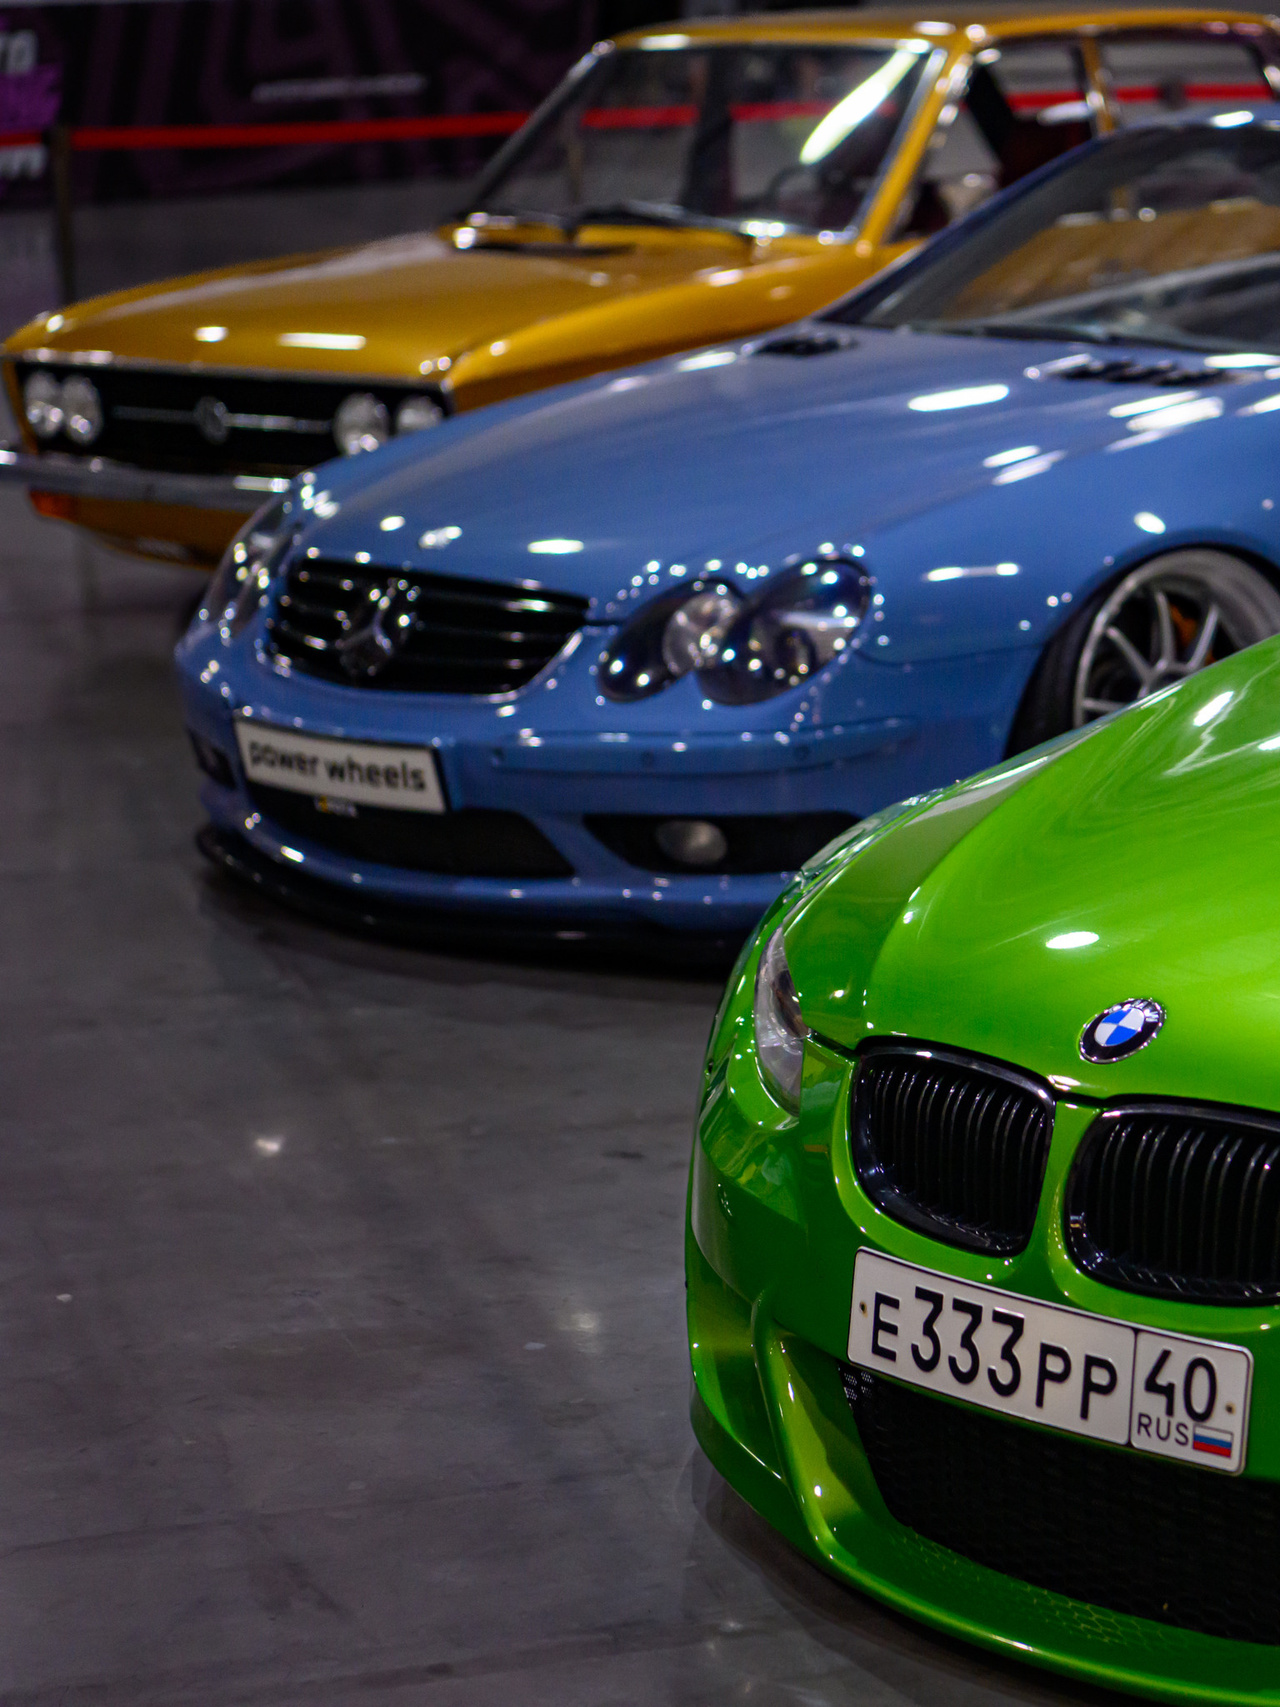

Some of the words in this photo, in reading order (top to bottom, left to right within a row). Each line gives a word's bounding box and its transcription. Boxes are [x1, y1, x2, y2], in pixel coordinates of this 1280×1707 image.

[249, 741, 319, 777] power
[325, 755, 426, 792] wheels
[1144, 1349, 1218, 1422] 40
[1136, 1413, 1190, 1446] RUS
